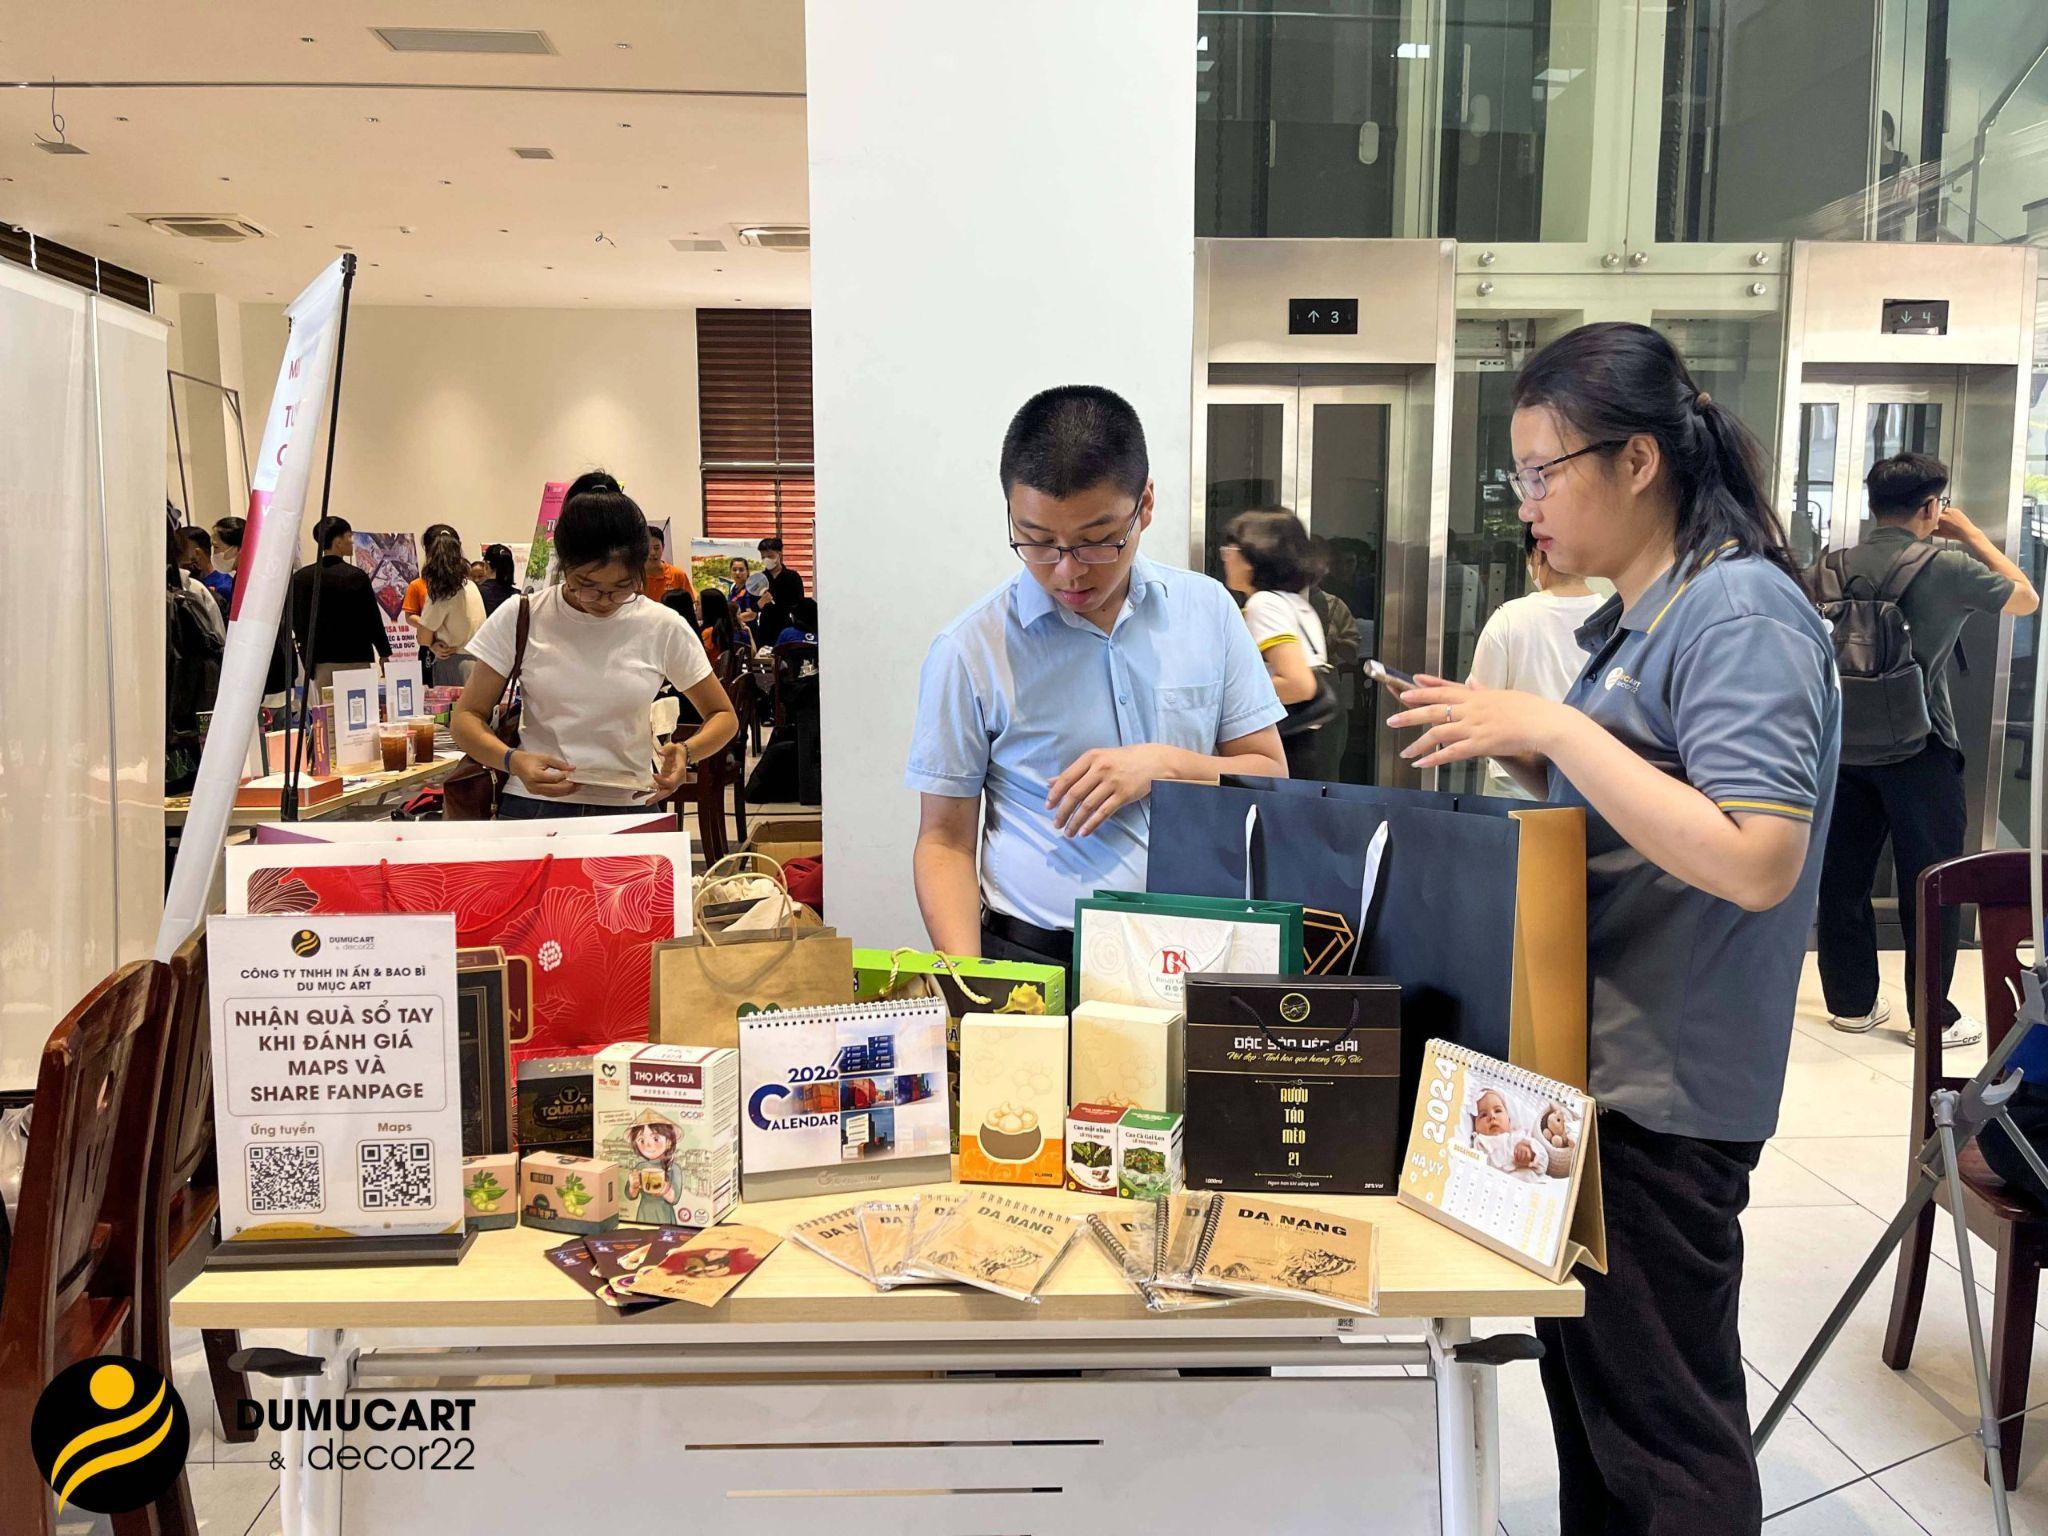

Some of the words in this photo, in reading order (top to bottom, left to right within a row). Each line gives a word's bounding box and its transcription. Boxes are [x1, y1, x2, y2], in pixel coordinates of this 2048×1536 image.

[1331, 311, 1339, 323] 3
[1922, 311, 1931, 324] 4
[329, 936, 375, 944] DUMUCART
[240, 966, 279, 979] CÔNG
[284, 969, 295, 978] TY
[300, 968, 332, 978] TNHH
[336, 968, 348, 978] IN
[353, 964, 370, 977] ẤN
[374, 968, 381, 977] &
[386, 967, 411, 977] BAO
[415, 964, 427, 977] BÌ
[297, 982, 314, 992] DU
[318, 981, 345, 994] MỤC
[350, 981, 371, 991] ART
[235, 1006, 299, 1031] NHẬN
[306, 1005, 355, 1026] QUÀ
[362, 999, 391, 1025] SỔ
[398, 1007, 433, 1024] TAY
[259, 1035, 295, 1051] KHI
[303, 1030, 366, 1050] ĐÁNH
[373, 1028, 413, 1049] GIÁ
[288, 1060, 348, 1076] MAPS
[356, 1054, 386, 1075] VÀ
[635, 1072, 653, 1084] THỌ
[655, 1071, 676, 1085] MỘC
[788, 1066, 839, 1083] 2026
[251, 1085, 320, 1102] SHARE
[327, 1083, 424, 1100] FANPAGE
[1423, 1057, 1457, 1144] 2024
[1284, 1107, 1304, 1123] TÁO
[251, 1122, 276, 1137] Ứng
[280, 1120, 315, 1137] tuyển
[378, 1122, 412, 1134] Maps
[1282, 1127, 1306, 1144] MÈO
[1288, 1152, 1300, 1166] 21
[976, 1206, 1001, 1220] DA
[1005, 1215, 1055, 1236] NANG
[1238, 1208, 1270, 1221] DA
[1280, 1214, 1348, 1237] NANG
